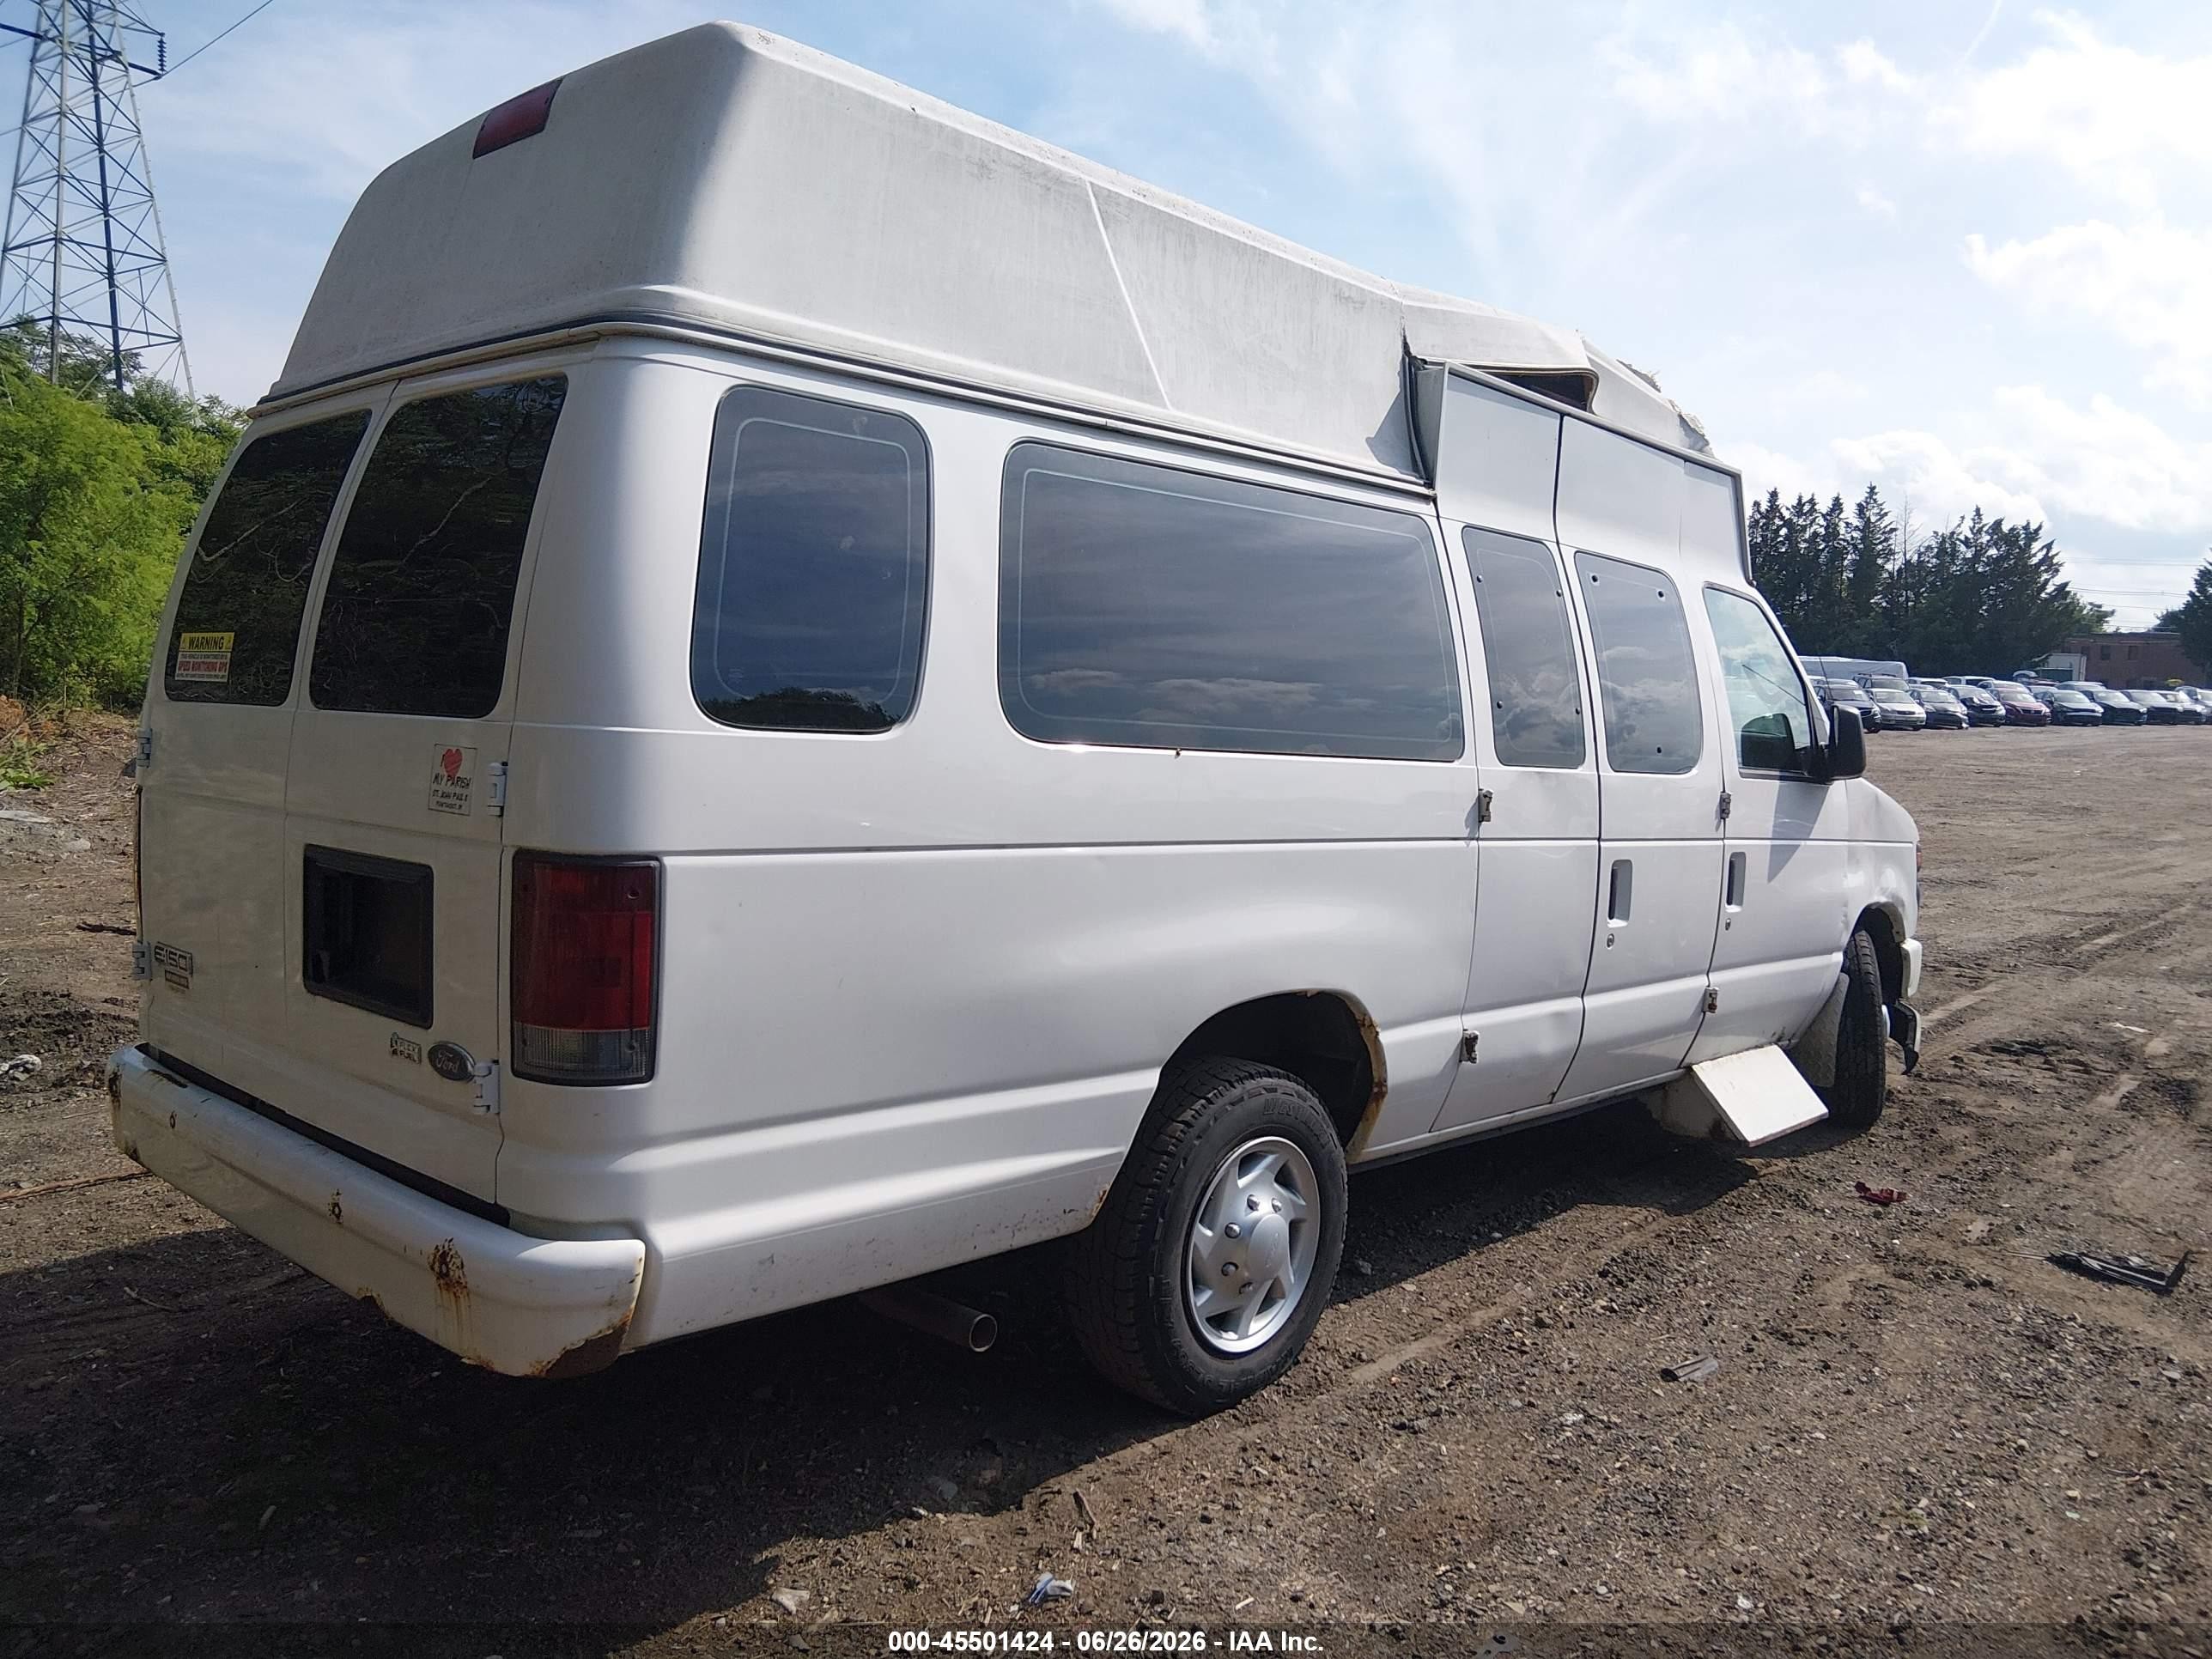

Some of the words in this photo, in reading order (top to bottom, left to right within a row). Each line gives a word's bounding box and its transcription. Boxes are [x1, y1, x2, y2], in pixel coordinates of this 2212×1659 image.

[188, 635, 224, 650] WARNING
[433, 772, 445, 786] MY
[445, 775, 471, 789] PARISH
[399, 1042, 417, 1054] FLEX
[399, 1049, 418, 1064] FUEL
[435, 1050, 459, 1073] Ford
